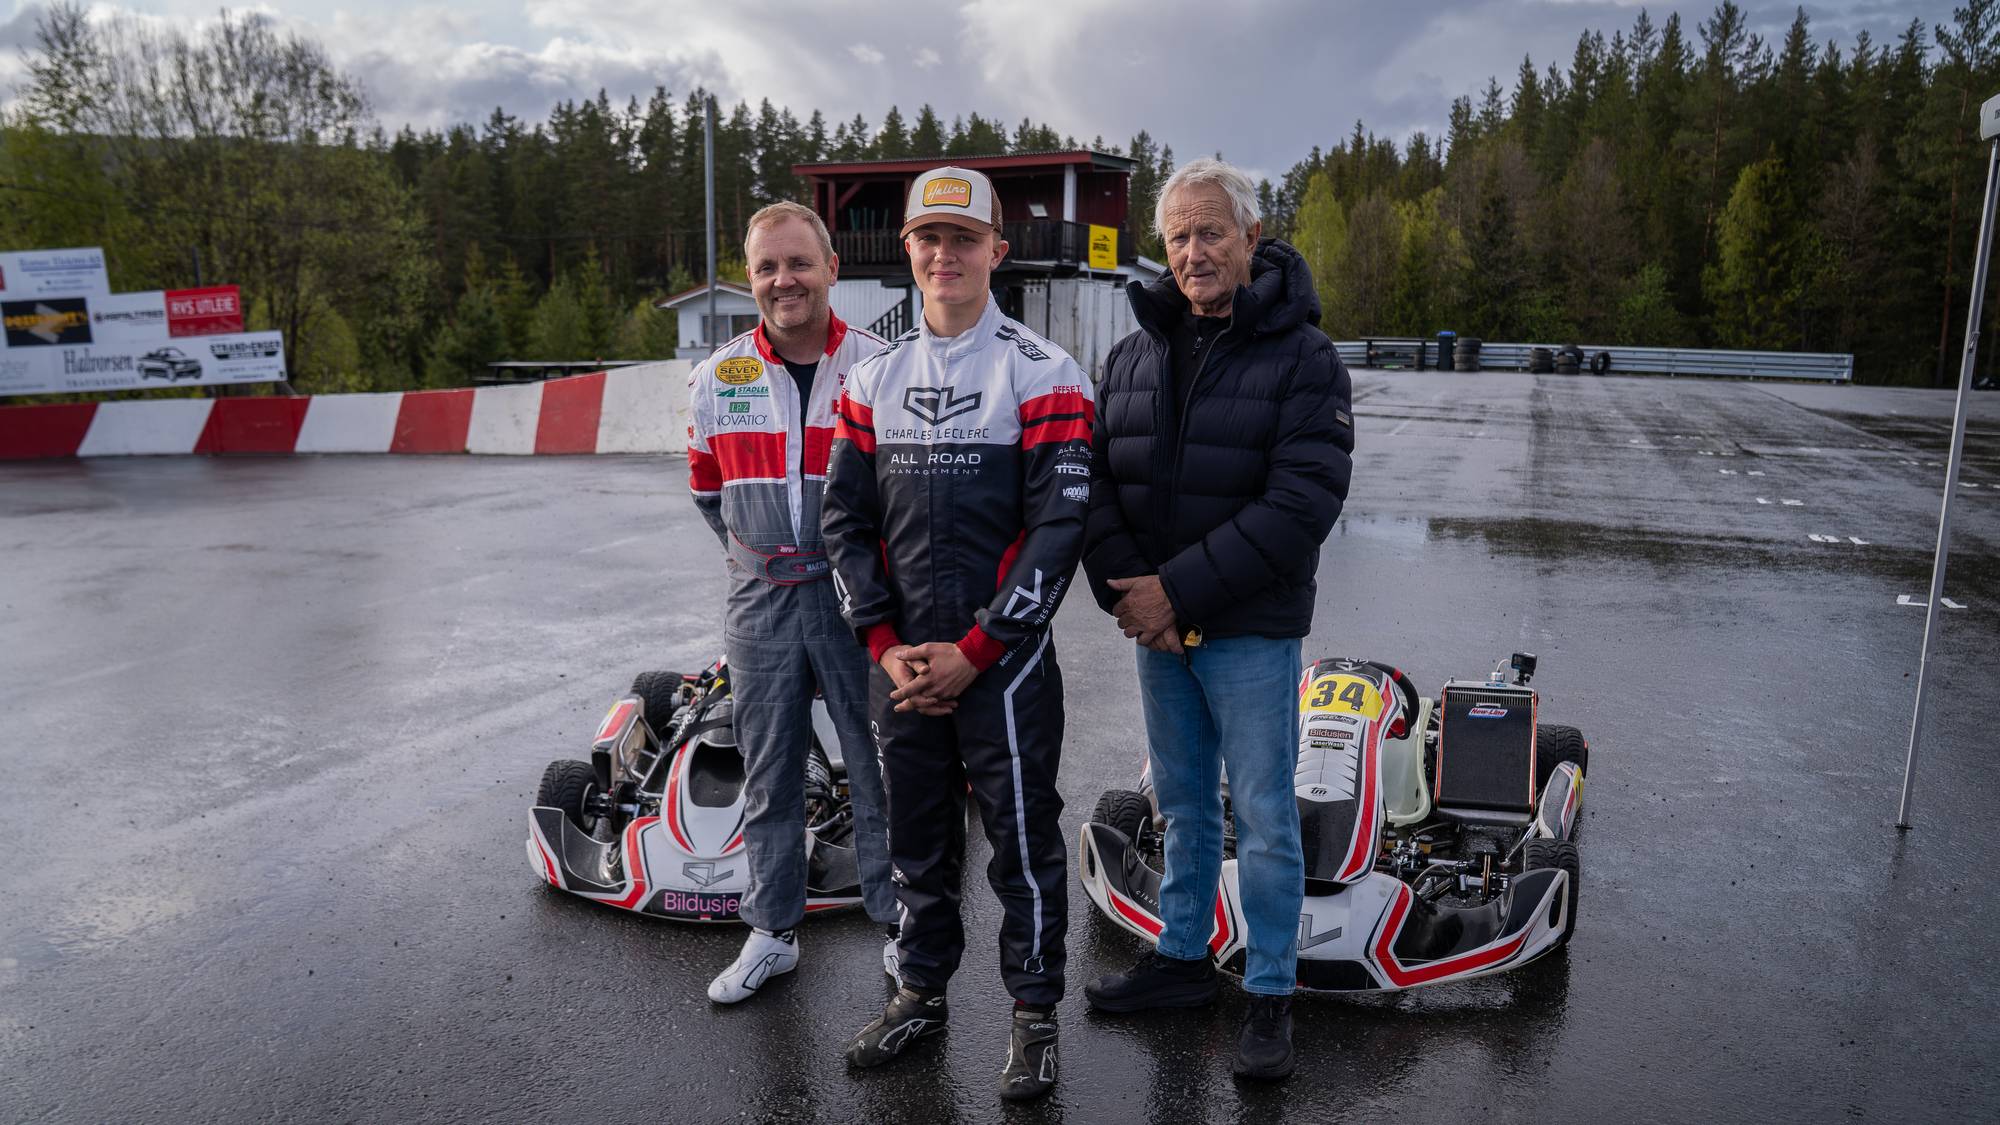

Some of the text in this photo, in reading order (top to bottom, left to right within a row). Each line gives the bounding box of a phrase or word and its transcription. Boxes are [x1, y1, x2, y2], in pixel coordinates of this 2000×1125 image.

[171, 301, 195, 315] RVS
[720, 366, 758, 374] SEVEN
[1052, 384, 1081, 393] OFFSET
[885, 428, 989, 440] CHARLES LECLERC
[890, 453, 981, 464] ALL ROAD
[1046, 577, 1066, 608] LECLERC
[1311, 680, 1365, 711] 34
[1471, 707, 1505, 715] New-Line
[1310, 729, 1352, 739] Bildusjen
[664, 892, 739, 916] Bildusje
